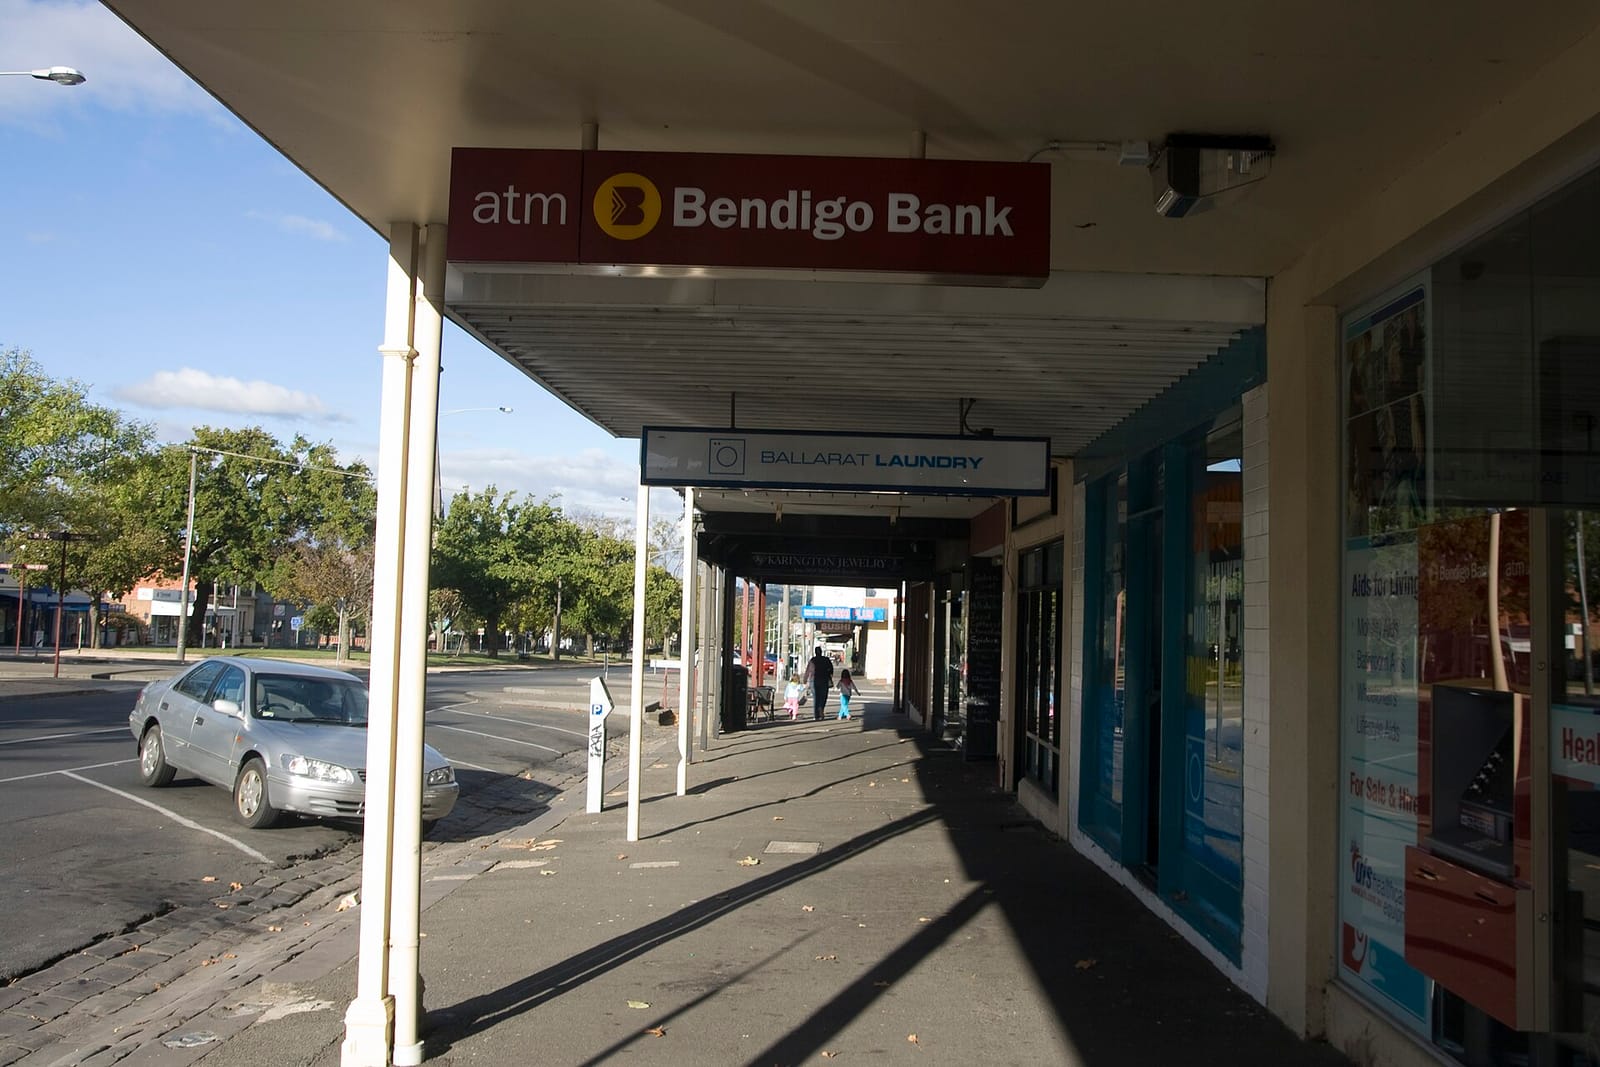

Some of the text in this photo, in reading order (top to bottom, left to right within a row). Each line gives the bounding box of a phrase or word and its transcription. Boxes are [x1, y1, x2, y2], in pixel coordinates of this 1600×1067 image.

[472, 184, 567, 225] atm
[672, 187, 1014, 241] Bendigo Bank
[761, 451, 983, 469] BALLARAT LAUNDRY
[837, 557, 887, 569] JEWELRY
[1504, 560, 1525, 577] atm
[1440, 564, 1470, 583] Bendigo
[1352, 573, 1371, 597] Aids
[1374, 572, 1389, 597] for
[820, 623, 851, 632] SUSHI
[1350, 772, 1363, 796] For
[1366, 776, 1385, 804] Sale
[1388, 783, 1395, 808] &
